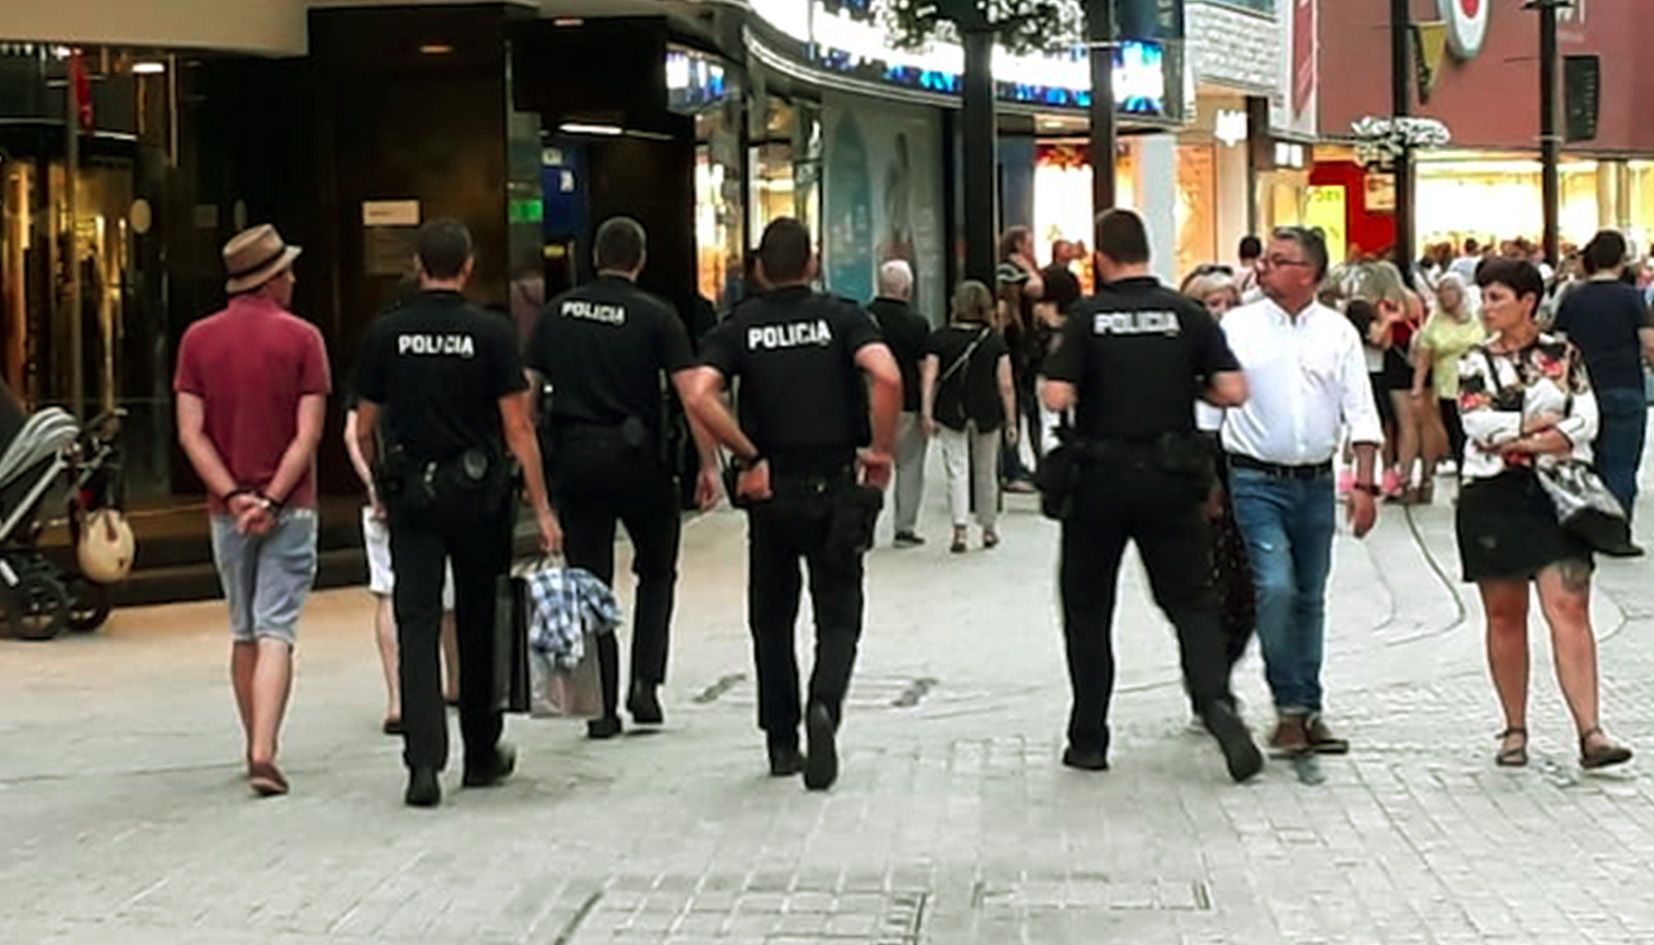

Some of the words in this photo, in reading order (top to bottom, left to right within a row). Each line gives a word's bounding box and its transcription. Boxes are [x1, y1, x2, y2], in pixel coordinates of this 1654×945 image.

[562, 301, 624, 323] POLICIA
[1094, 311, 1179, 334] POLICIA
[399, 335, 474, 355] POLICIA
[748, 319, 831, 349] POLICIA
